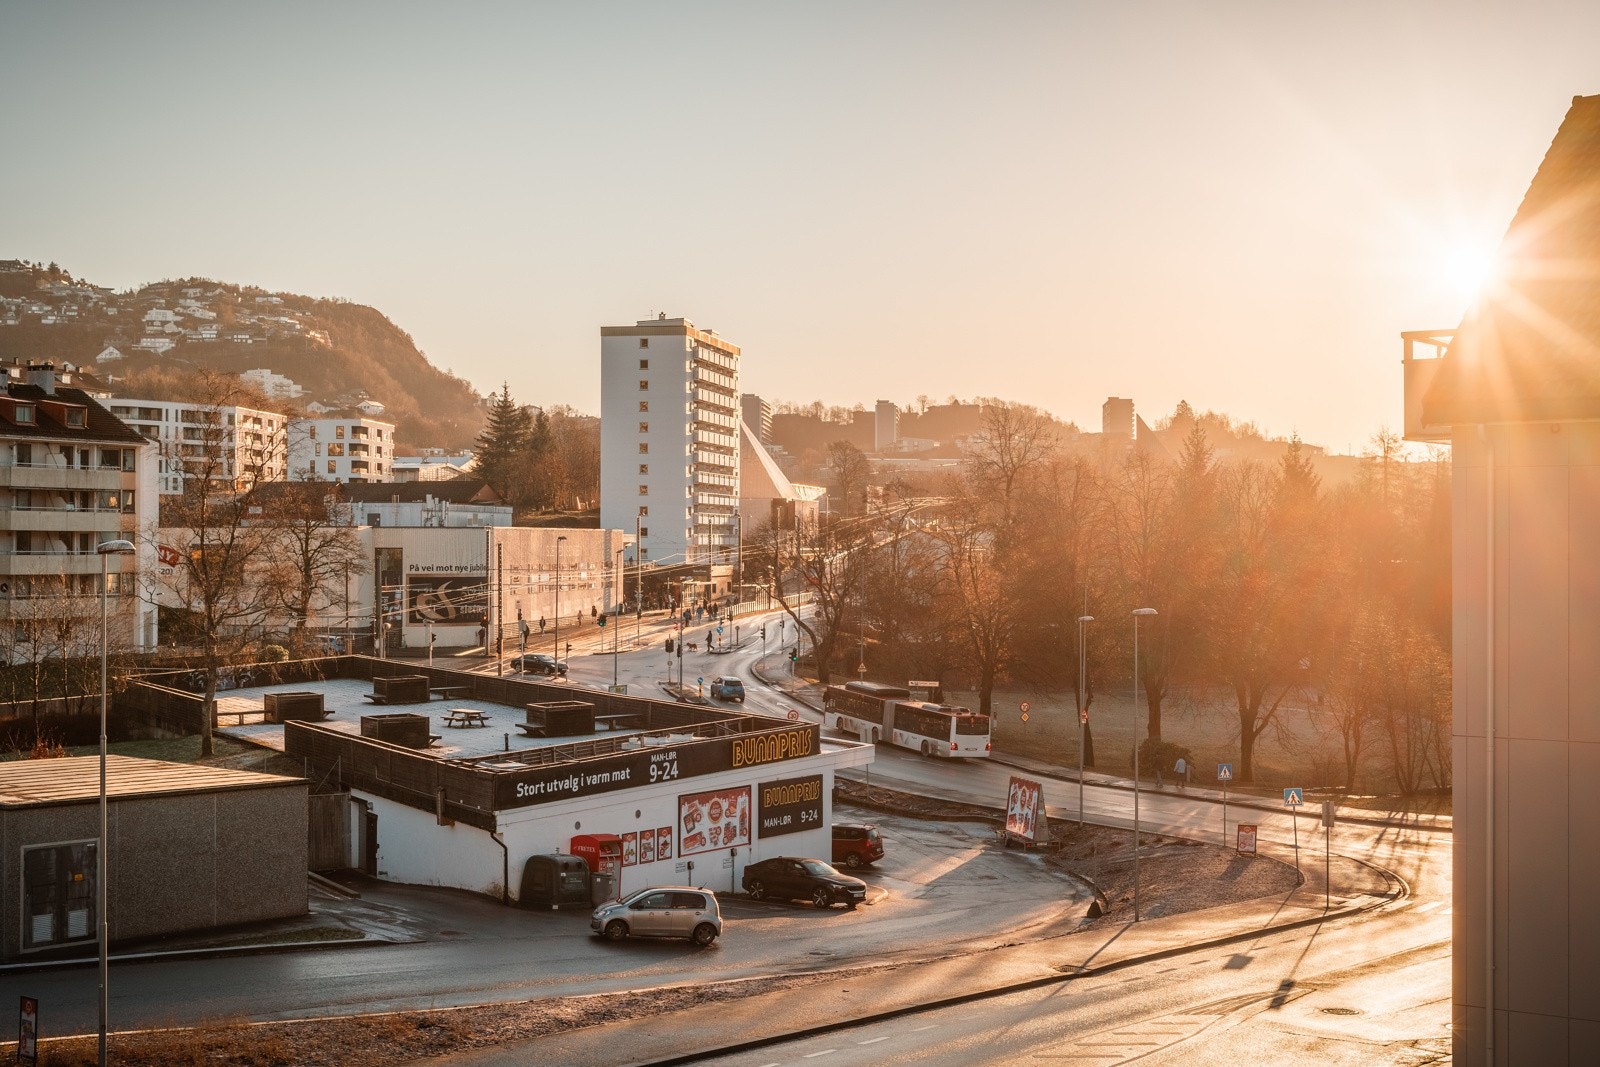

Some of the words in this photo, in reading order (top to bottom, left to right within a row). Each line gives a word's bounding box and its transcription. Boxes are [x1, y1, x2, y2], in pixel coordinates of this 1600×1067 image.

[409, 563, 420, 572] På
[421, 564, 434, 572] vei
[435, 564, 453, 572] mot
[454, 565, 469, 573] nye
[651, 751, 677, 763] MAN-LØR
[733, 729, 811, 766] BUNNPRIS
[650, 760, 679, 783] 9-24
[516, 781, 545, 797] Stort
[546, 774, 579, 792] utvalg
[580, 773, 585, 787] i
[586, 772, 610, 786] varm
[612, 767, 631, 782] mat
[764, 780, 820, 808] BUNNPRIS
[764, 814, 792, 828] MAN-LØR
[800, 808, 818, 823] 9-24
